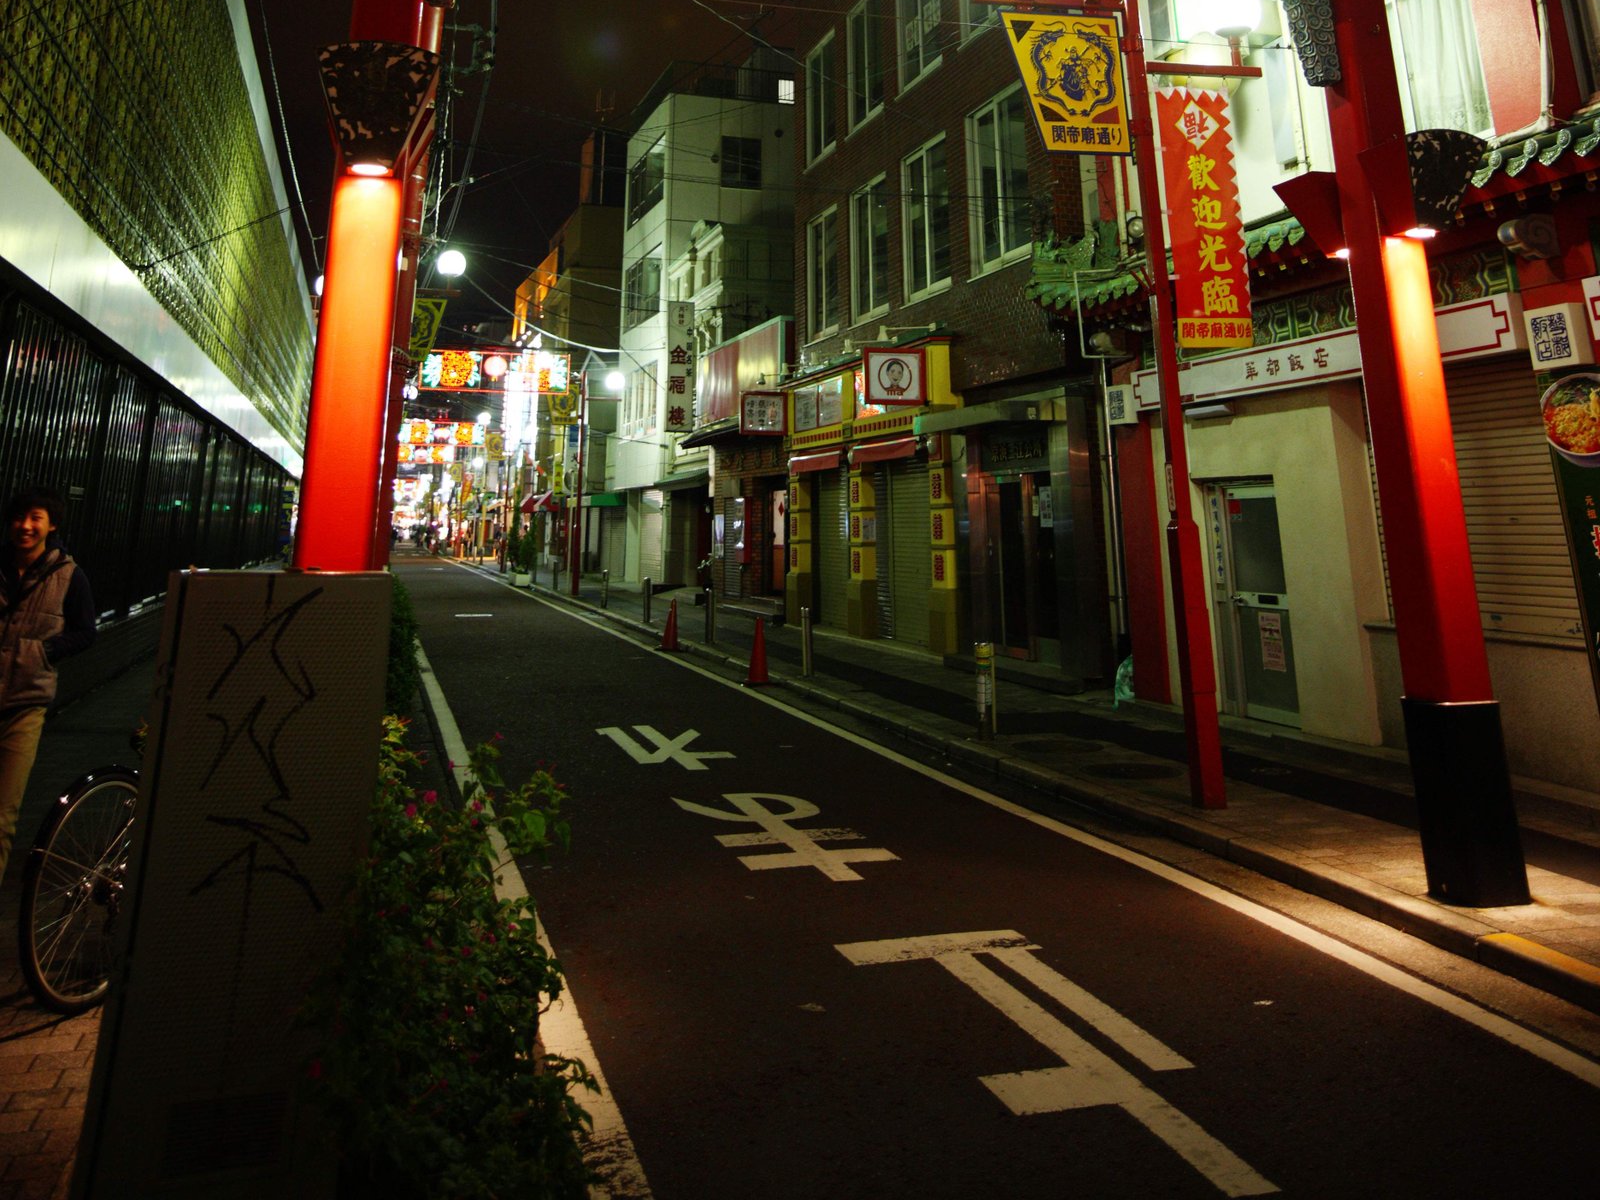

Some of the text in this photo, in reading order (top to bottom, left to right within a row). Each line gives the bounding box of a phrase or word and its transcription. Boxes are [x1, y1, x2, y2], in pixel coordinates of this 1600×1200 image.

[1051, 124, 1123, 146] 関帝廟通り
